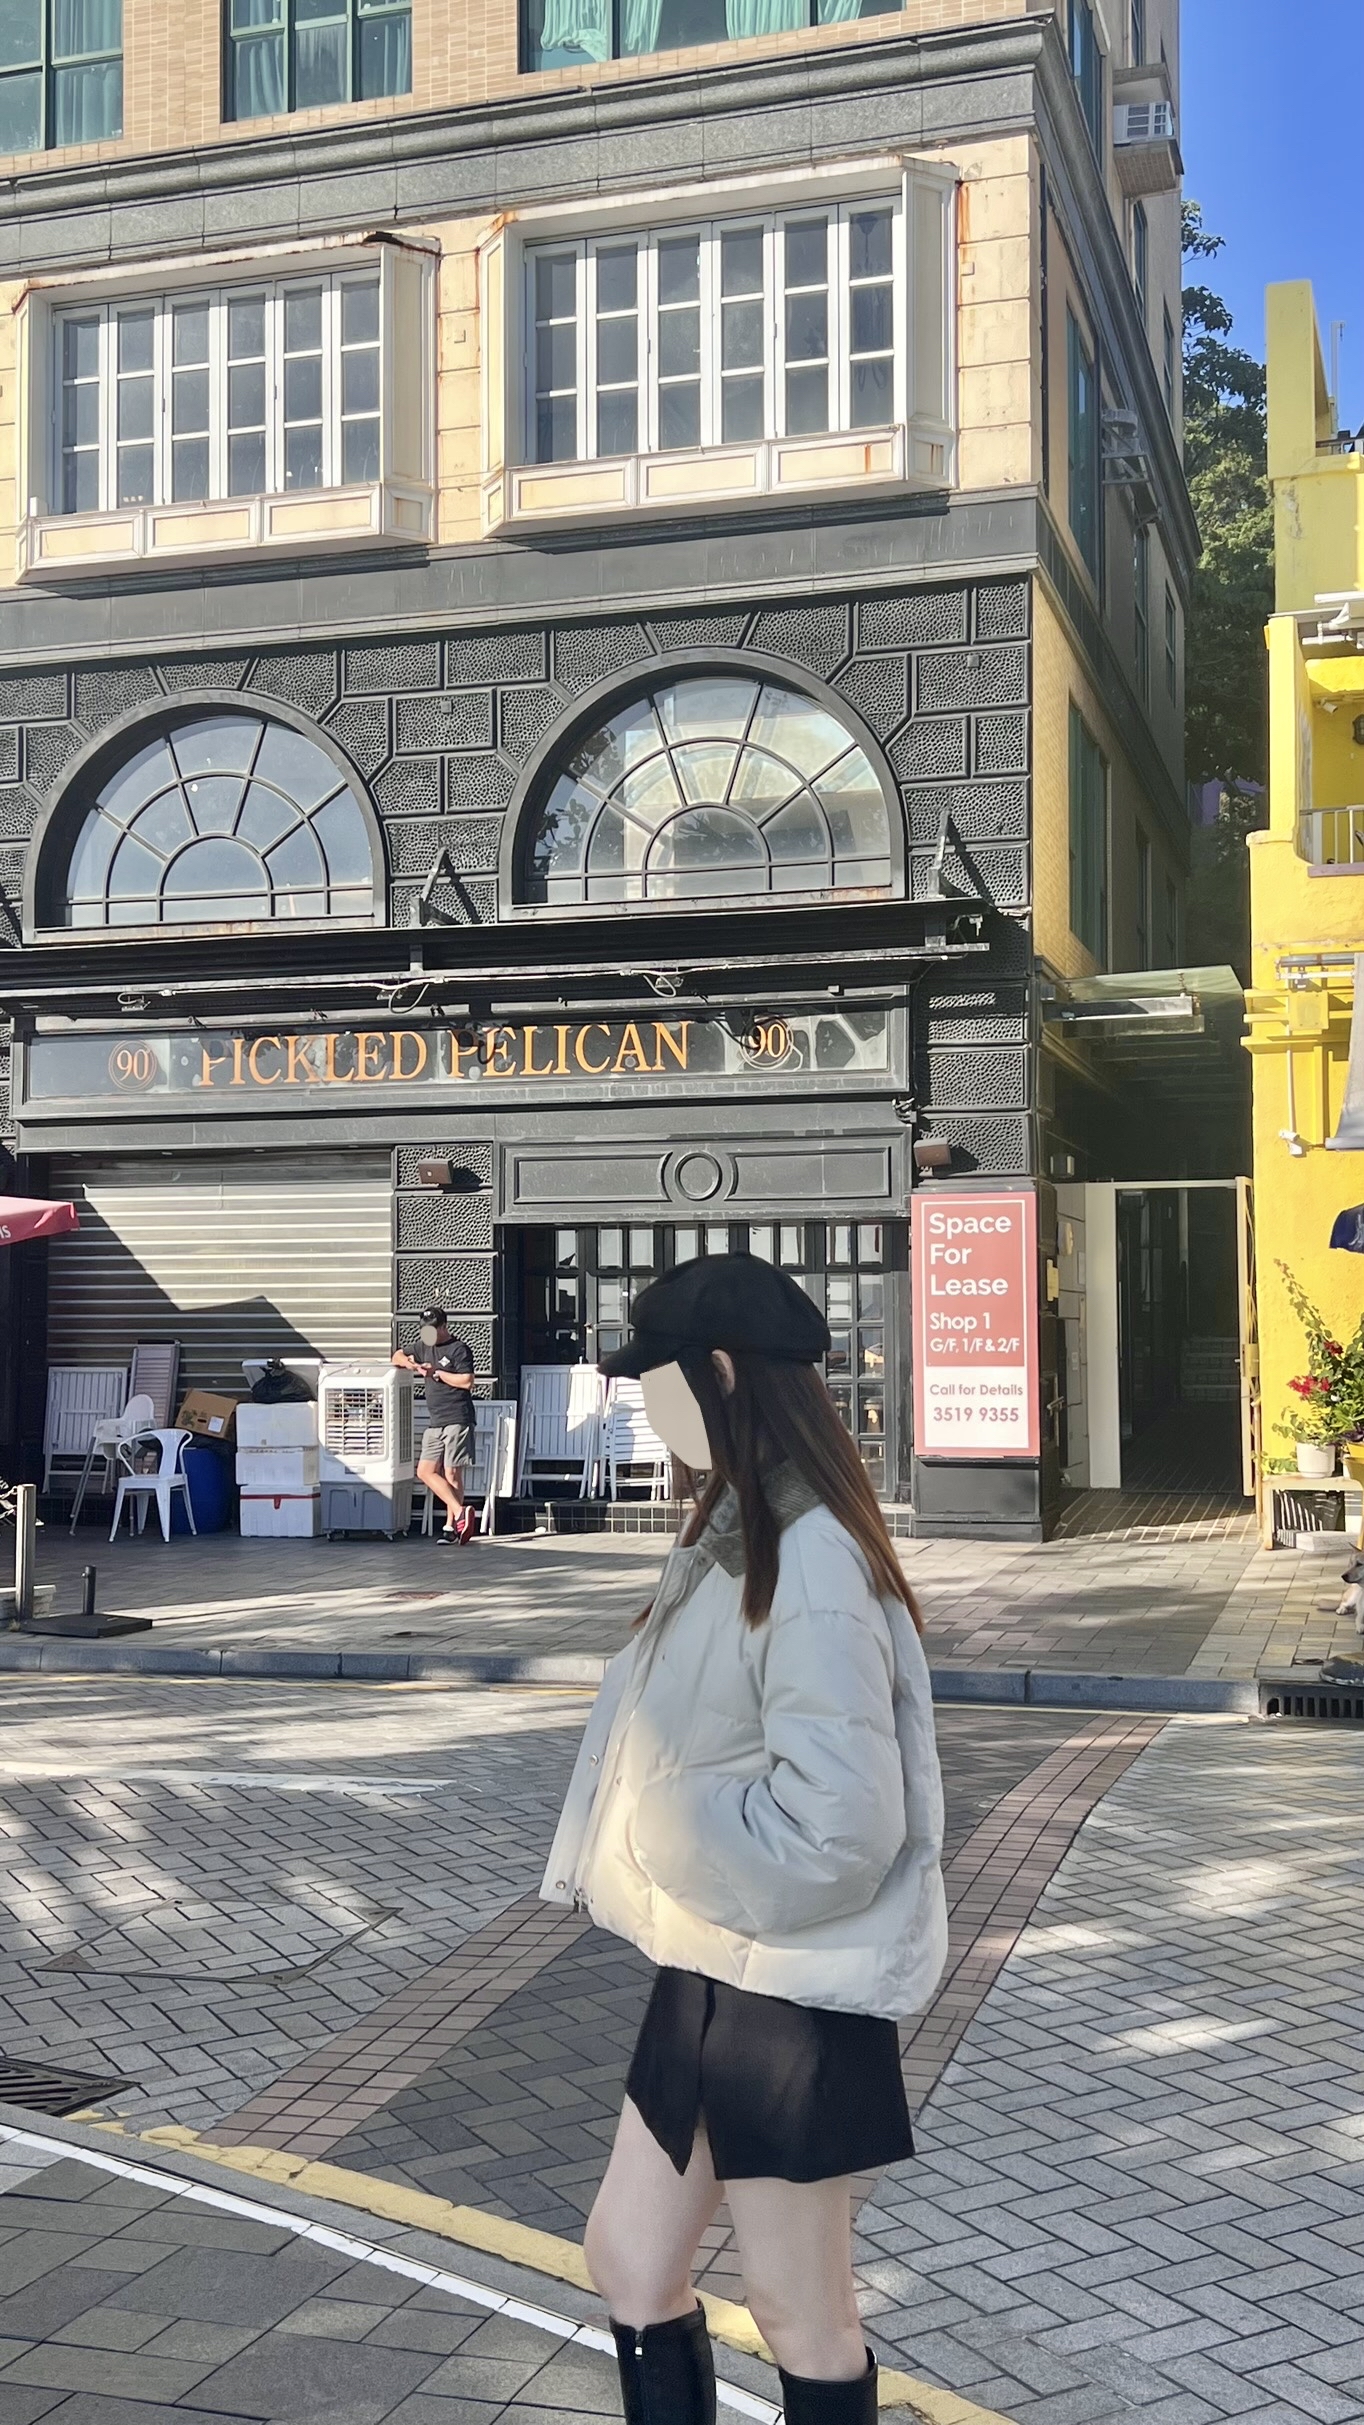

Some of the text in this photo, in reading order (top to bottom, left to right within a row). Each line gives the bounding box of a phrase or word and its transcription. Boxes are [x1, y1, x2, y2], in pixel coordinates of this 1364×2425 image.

[116, 1048, 150, 1081] 90
[200, 1030, 428, 1087] PICKLED
[447, 1020, 694, 1078] PELICAN
[929, 1212, 1012, 1240] Space
[930, 1243, 973, 1265] For
[930, 1273, 1009, 1296] Lease
[929, 1311, 991, 1334] Shop 1
[929, 1337, 1020, 1354] G/F, 1/F & 2/F
[929, 1384, 1024, 1396] Call for Details
[933, 1406, 1019, 1422] 3519 9355
